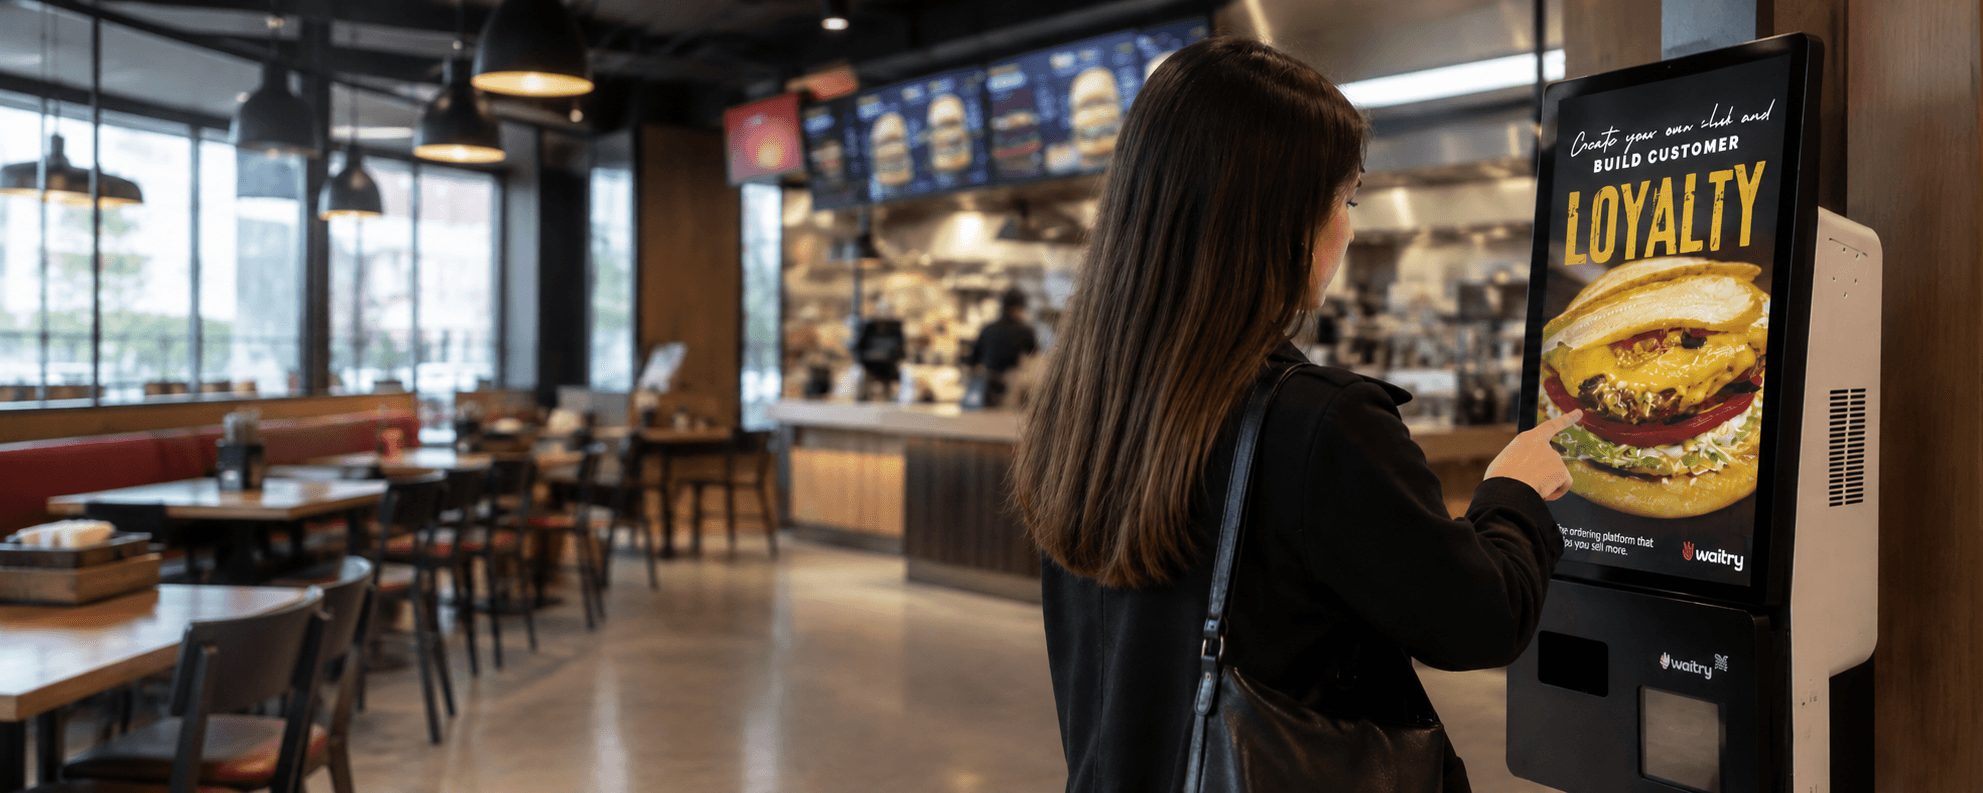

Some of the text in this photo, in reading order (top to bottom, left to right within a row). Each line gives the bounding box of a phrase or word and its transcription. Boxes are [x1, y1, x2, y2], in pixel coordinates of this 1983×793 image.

[1741, 98, 1776, 123] and
[1593, 135, 1739, 173] BUILD CUSTOMER
[1564, 160, 1767, 266] LOYALTY
[1569, 527, 1601, 542] ordering
[1602, 532, 1636, 545] platform
[1637, 536, 1654, 548] that
[1574, 540, 1590, 551] you
[1591, 542, 1604, 552] sell
[1605, 544, 1628, 556] more.
[1695, 548, 1744, 572] waitry
[1670, 658, 1712, 680] waitry
